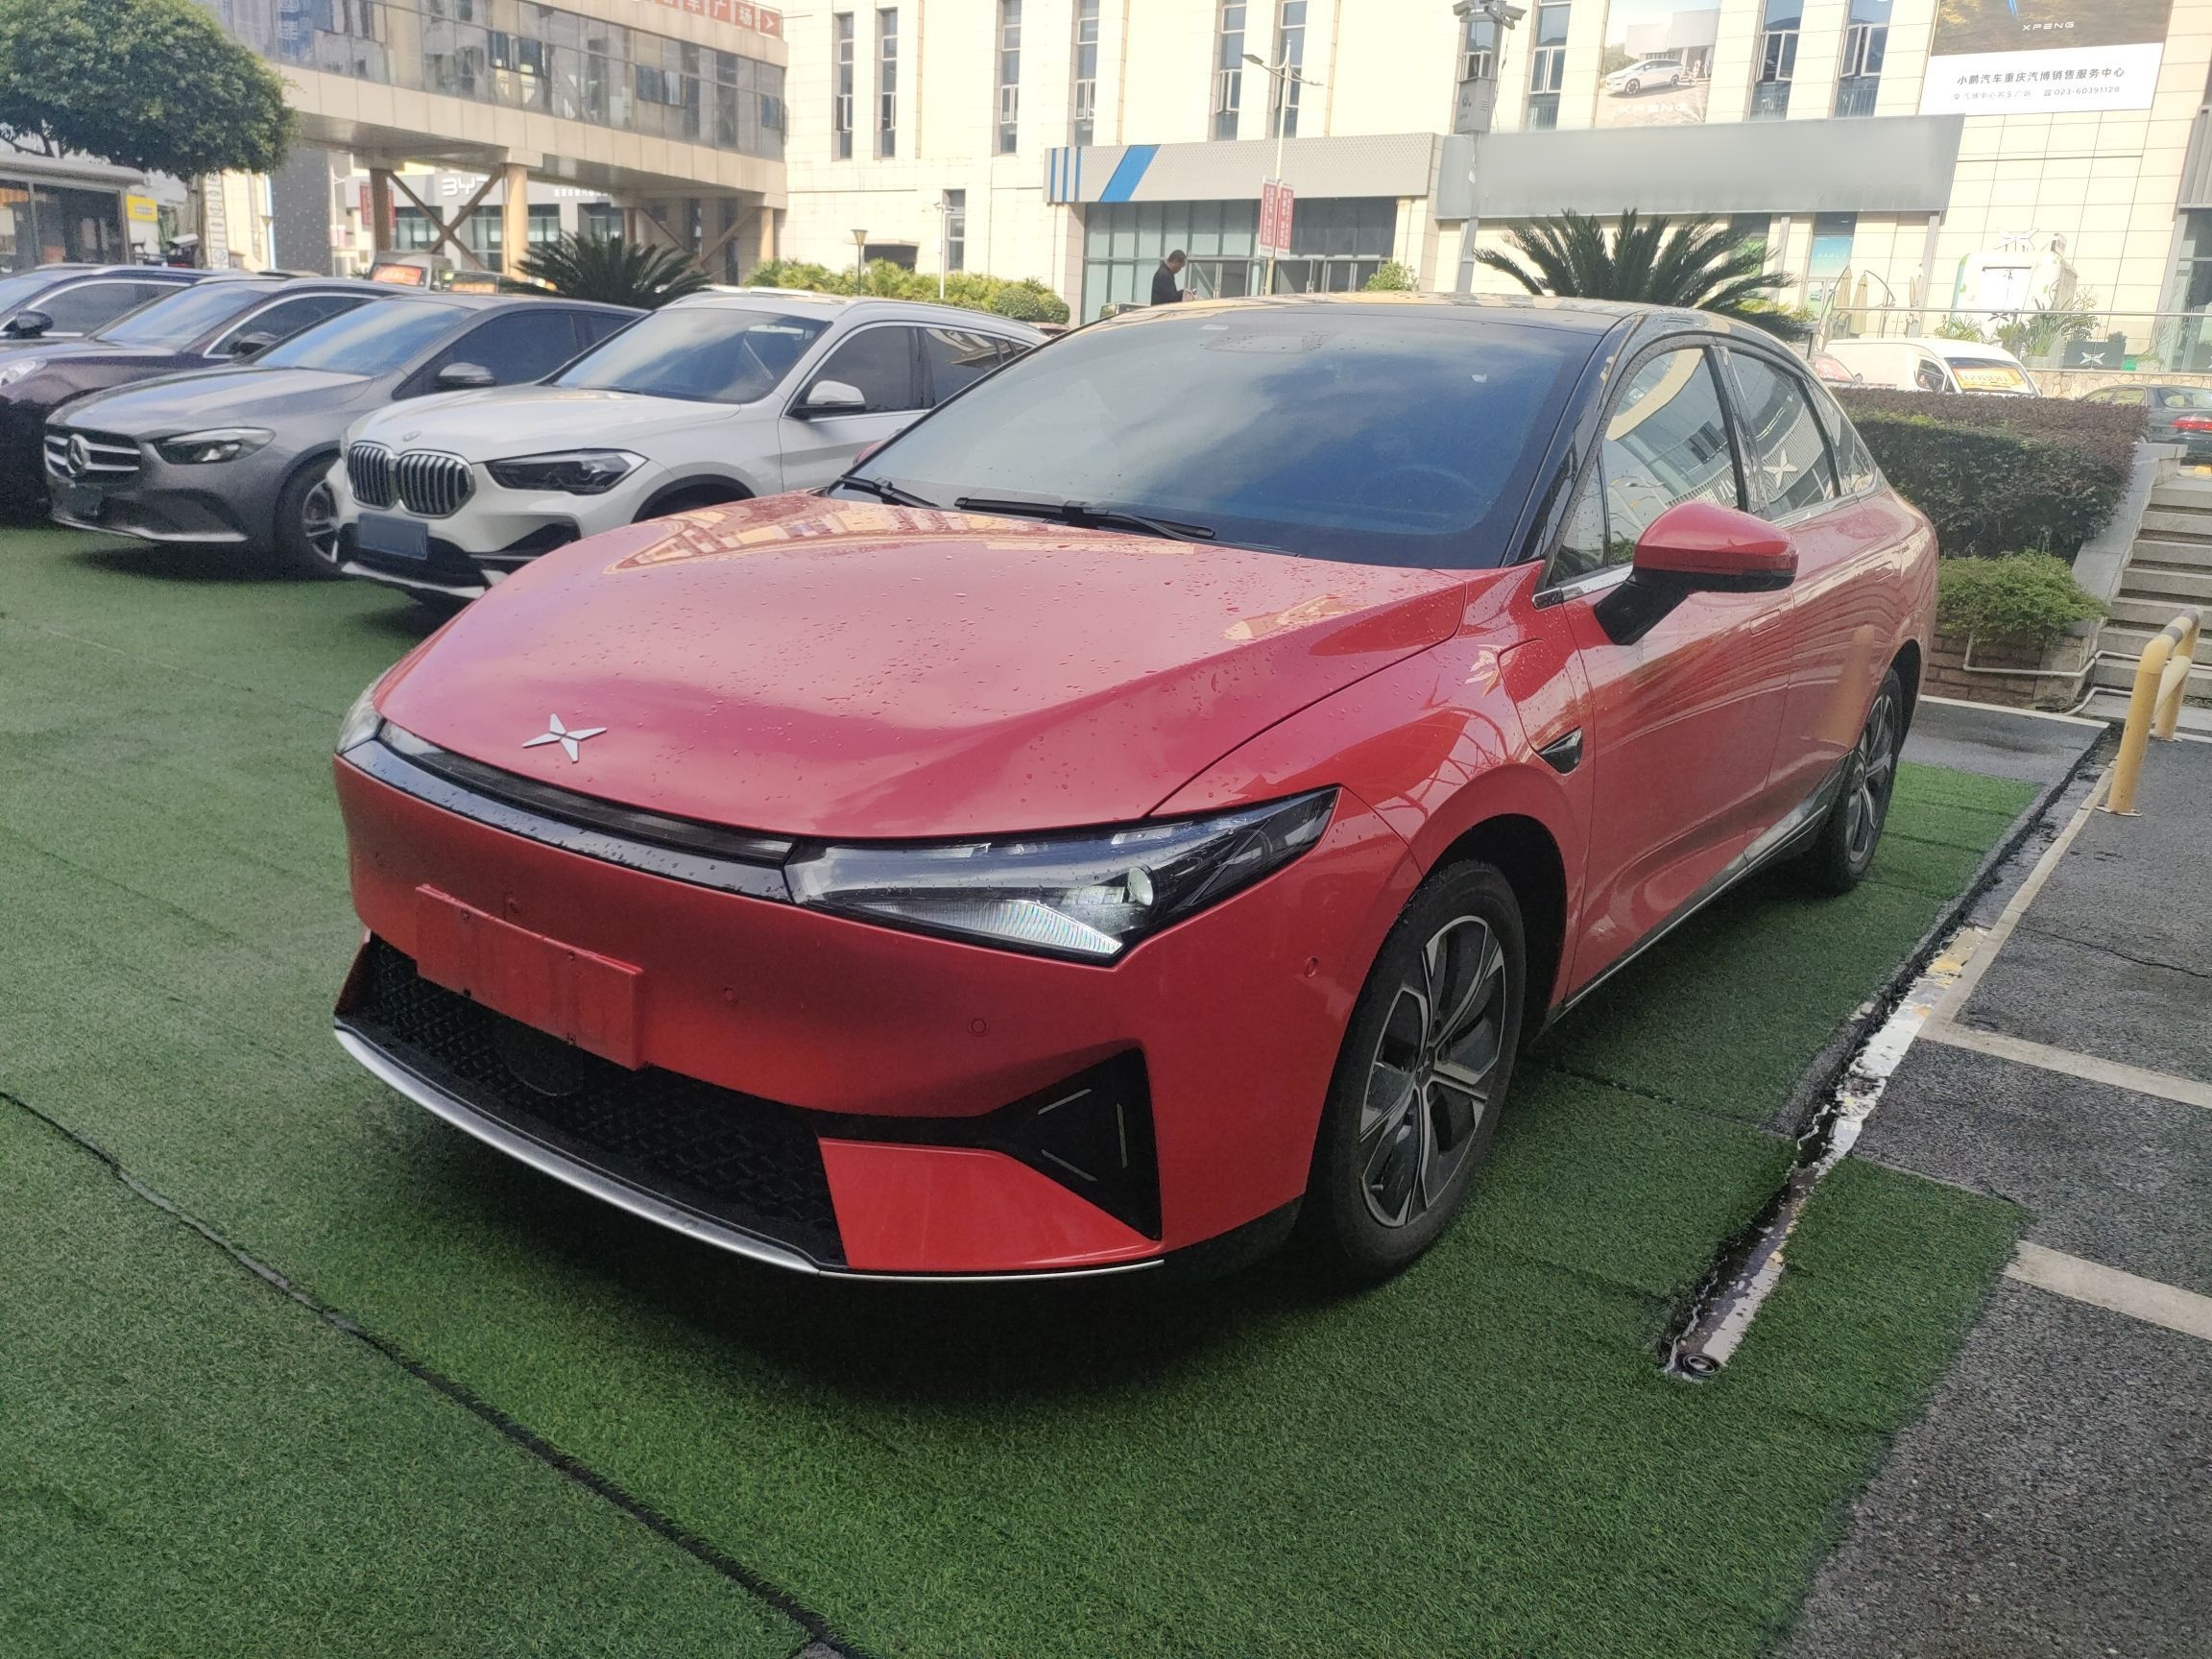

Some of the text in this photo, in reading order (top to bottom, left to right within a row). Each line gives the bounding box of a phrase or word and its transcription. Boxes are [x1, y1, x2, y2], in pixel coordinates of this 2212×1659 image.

[662, 0, 753, 26] 车广场
[2021, 21, 2075, 31] XPENG
[1957, 67, 2125, 84] 小鹏汽车重庆汽博销售服务中心
[2054, 86, 2120, 96] 023-60391128
